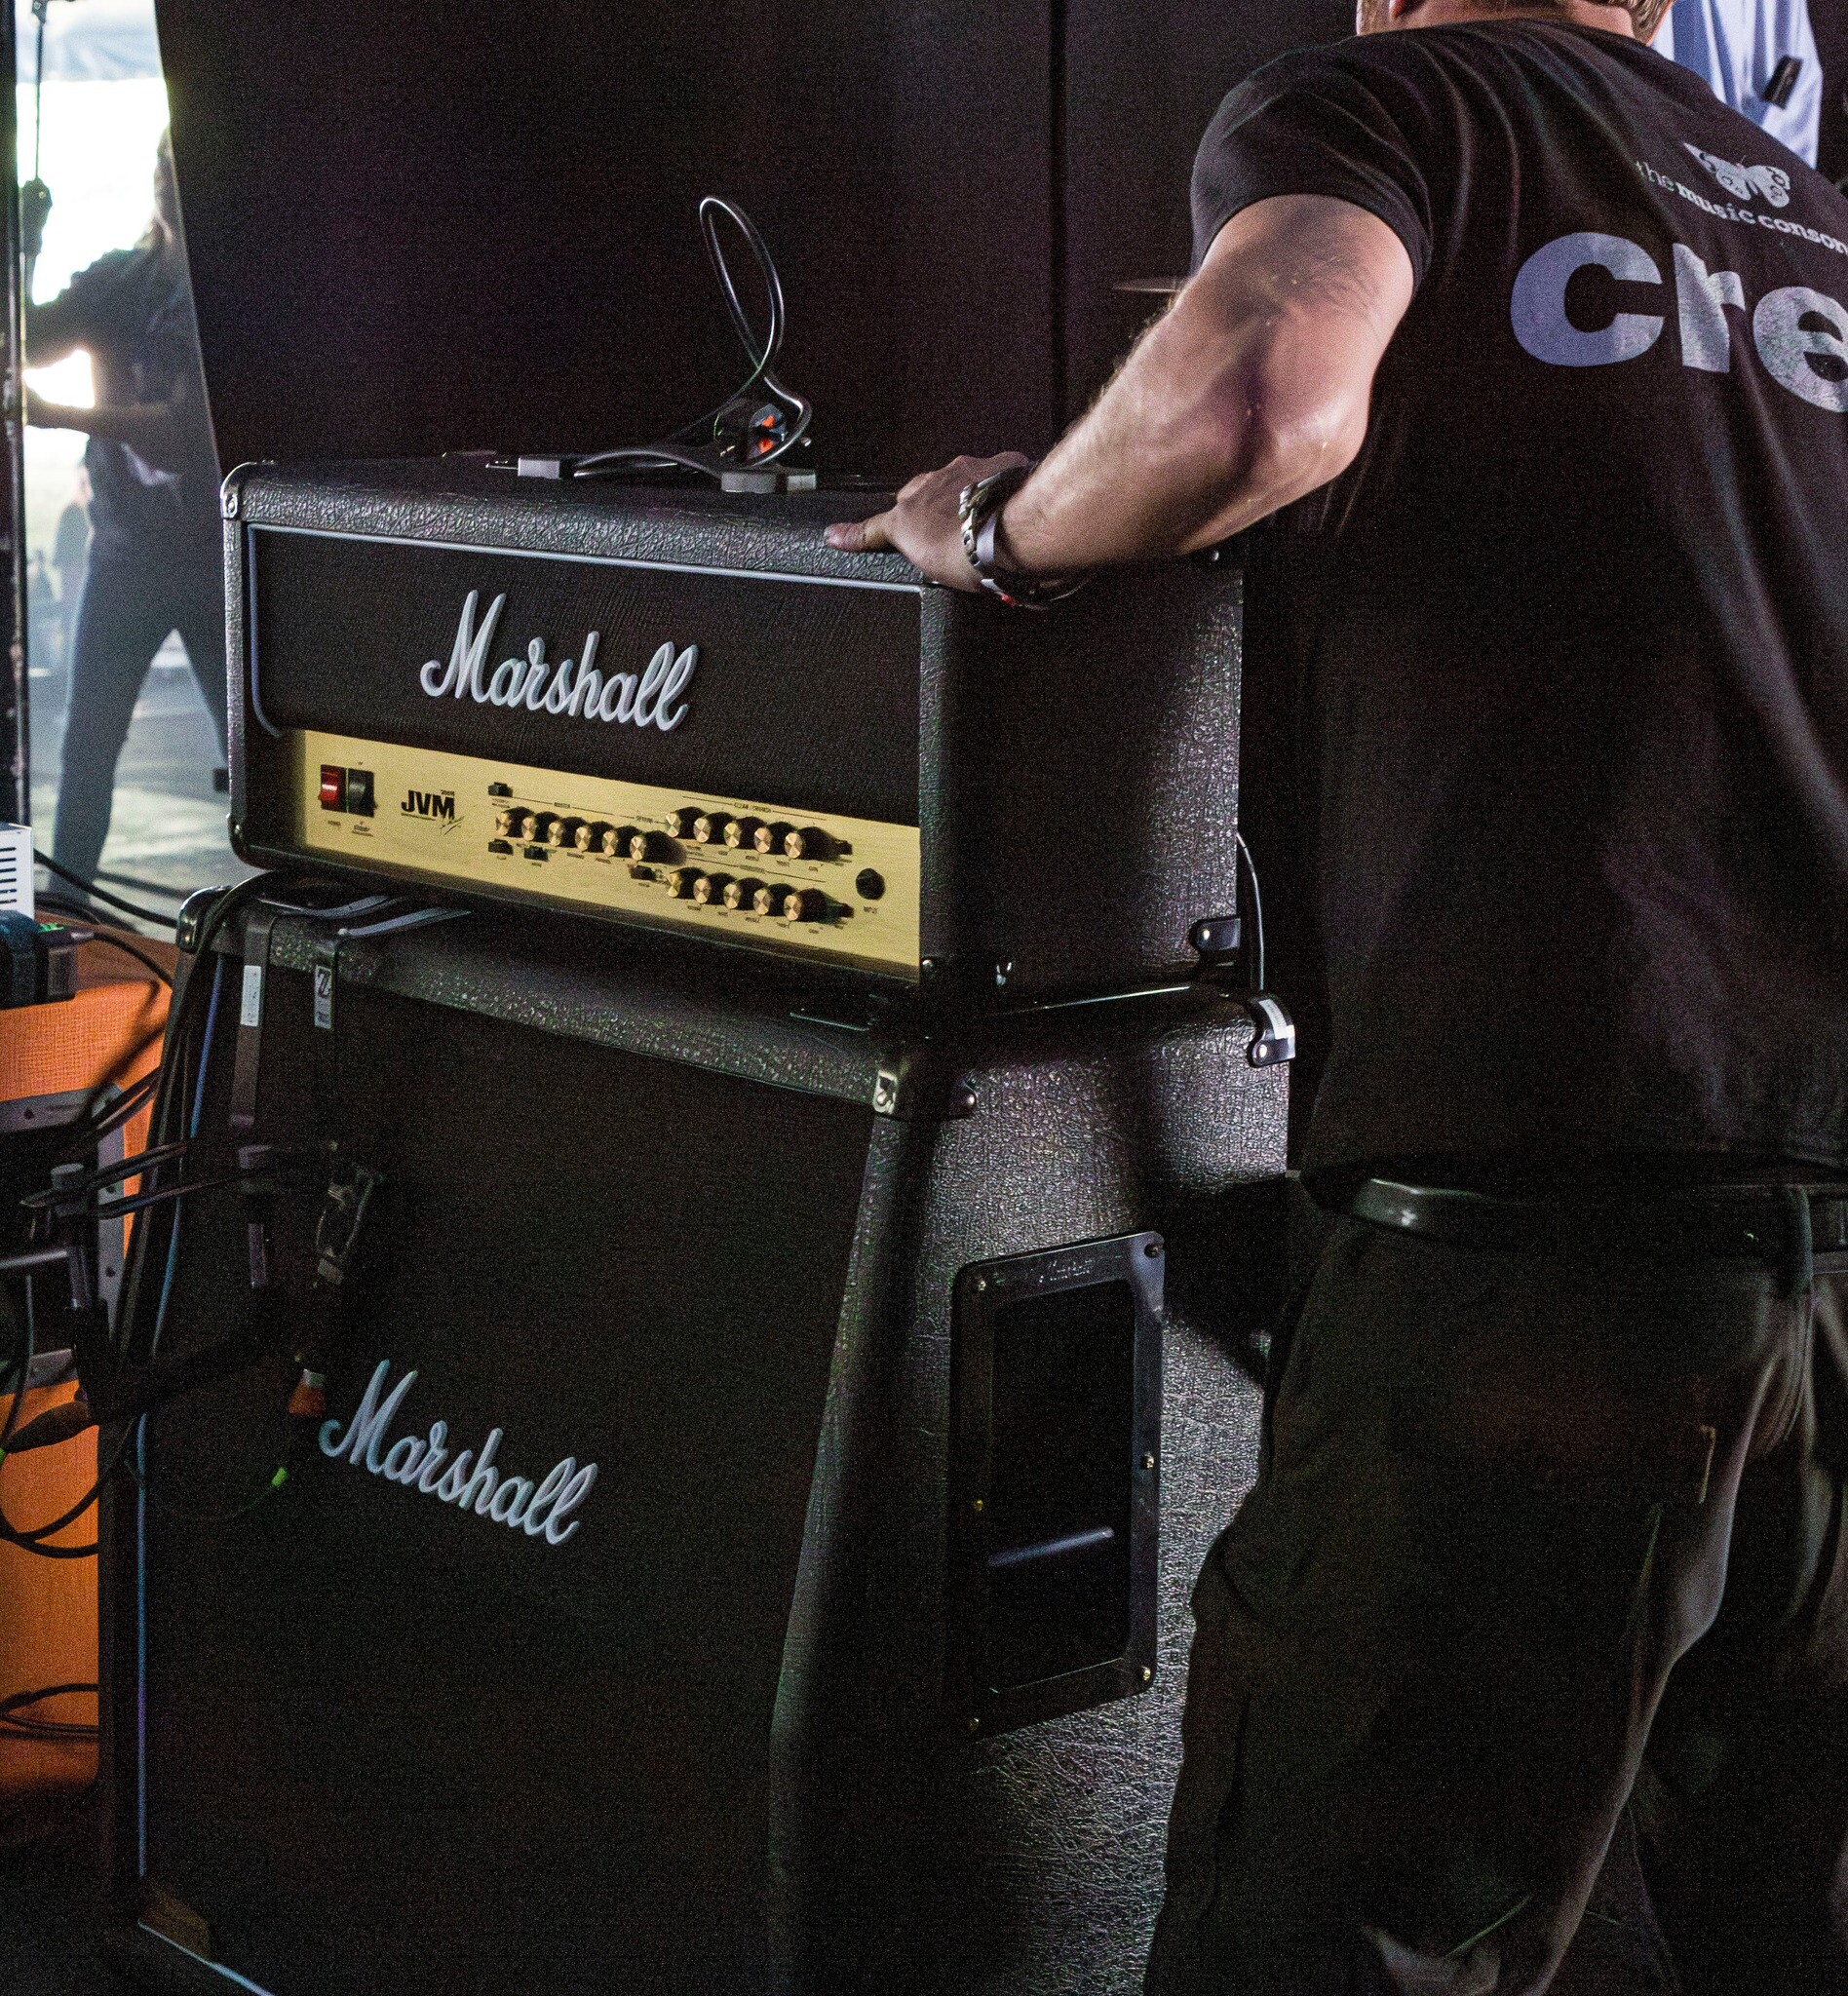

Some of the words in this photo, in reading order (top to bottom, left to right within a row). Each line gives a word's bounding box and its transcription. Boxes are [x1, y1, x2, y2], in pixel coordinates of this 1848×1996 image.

[420, 589, 699, 731] Marshall
[401, 789, 455, 820] JVM
[318, 1359, 599, 1545] Marshall
